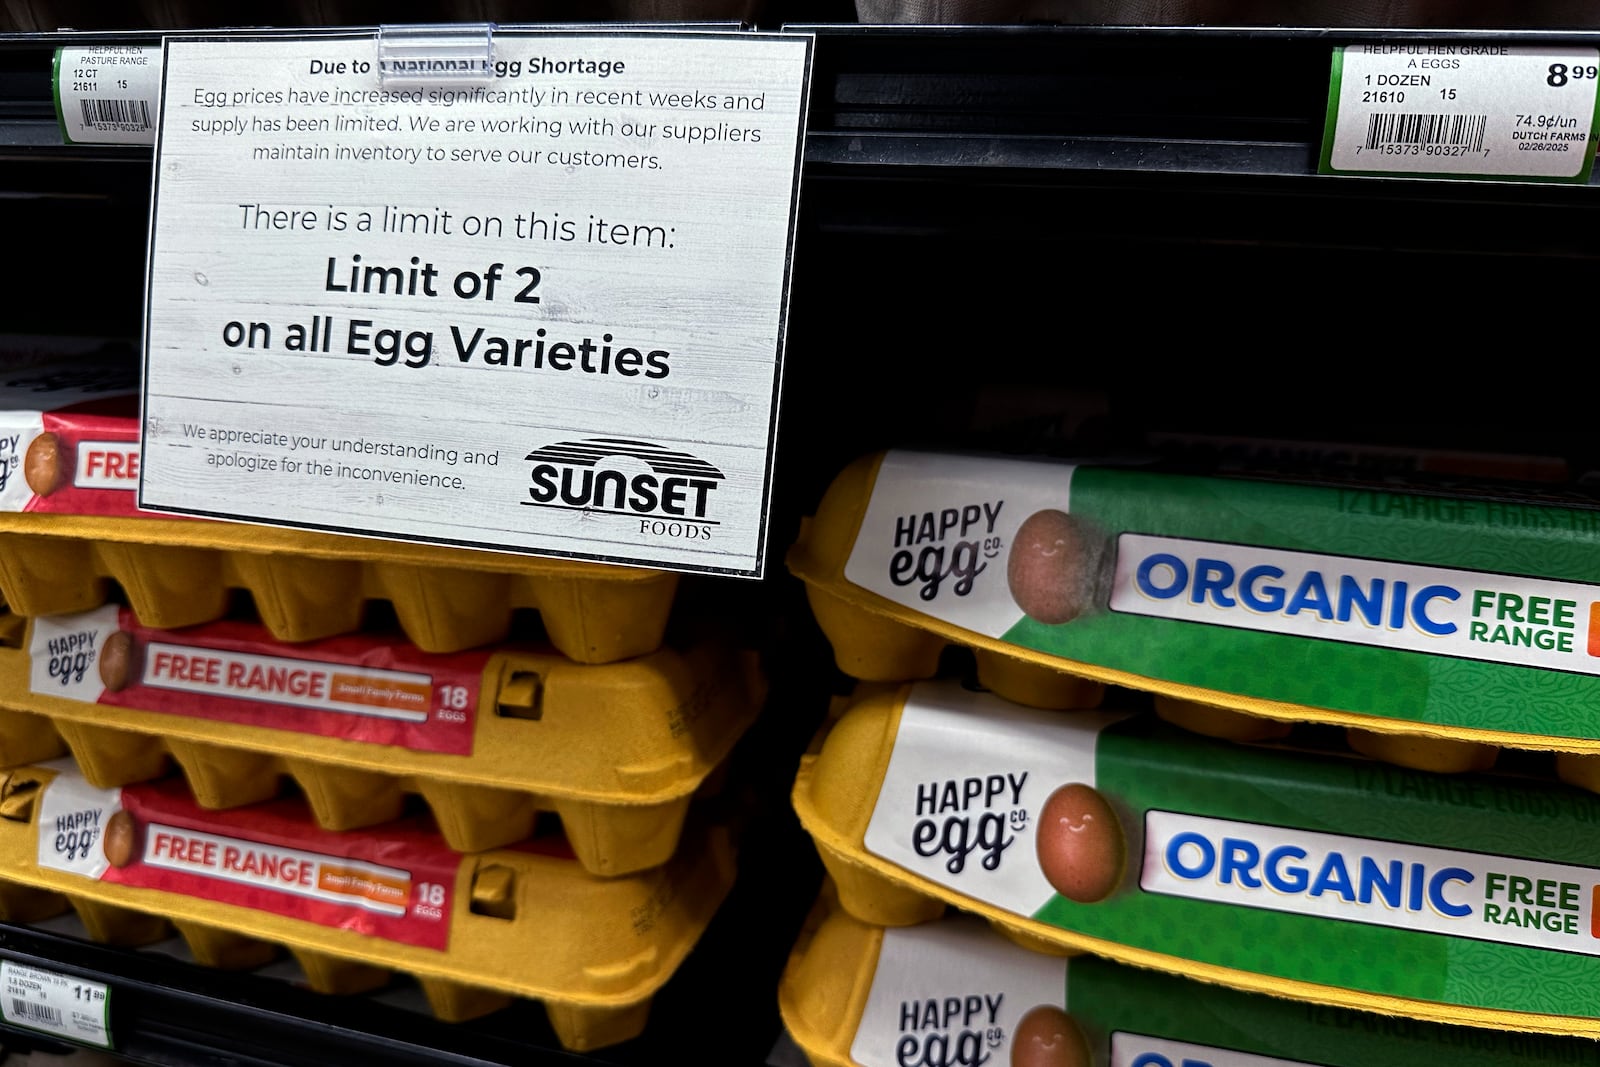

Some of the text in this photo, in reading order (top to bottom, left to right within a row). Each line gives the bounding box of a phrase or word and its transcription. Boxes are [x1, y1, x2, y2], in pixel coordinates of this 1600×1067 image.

[81, 56, 148, 65] PASTURE RANGE
[1364, 45, 1508, 56] HELPFUL HEN GRADE
[1408, 58, 1460, 69] A EGGS
[74, 69, 98, 78] 12 CT
[310, 59, 346, 74] Due
[352, 60, 371, 74] to
[528, 58, 625, 78] Shortage
[1365, 74, 1430, 86] 1 DOZEN
[73, 82, 98, 92] 21611
[117, 80, 128, 88] 15
[1362, 88, 1456, 103] 21610 15
[194, 87, 765, 110] Egg prices have increased significantly in recent weeks and
[192, 115, 762, 144] supply has been limited. We are working with our suppliers
[1512, 131, 1548, 140] DUTCH
[1550, 132, 1586, 141] FARMS
[253, 144, 662, 170] maintain inventory to serve our customers.
[1356, 144, 1490, 157] 7 15373 90327 7
[1518, 142, 1569, 152] 02/26/2025
[239, 204, 676, 248] There is a limit on this item:
[326, 254, 541, 304] Limit of 2
[223, 316, 670, 379] on all Egg Varieties
[183, 424, 500, 466] We appreciate your understanding and
[87, 451, 139, 479] FRE
[207, 452, 466, 490] apologize for the inconvenience.
[529, 464, 718, 518] SUNSET
[640, 520, 712, 542] FOODS
[894, 500, 1004, 548] HAPPY
[890, 541, 988, 601] egg
[1135, 552, 1462, 638] ORGANIC
[1472, 589, 1577, 629] FREE
[48, 630, 98, 656] HAPPY
[1469, 622, 1574, 654] RANGE
[48, 651, 91, 686] egg
[153, 652, 326, 698] FREE RANGE
[439, 685, 468, 709] 18
[437, 709, 466, 723] EGGS
[916, 772, 1028, 816] HAPPY
[56, 808, 102, 832] HAPPY
[55, 830, 96, 860] egg
[913, 810, 1030, 874] egg CO.
[154, 833, 314, 886] FREE RANGE
[1164, 831, 1476, 920] ORGANIC
[418, 882, 445, 908] 18
[1485, 872, 1580, 911] FREE
[414, 904, 442, 920] EGGS
[1483, 903, 1580, 936] RANGE
[898, 993, 1004, 1031] HAPPY
